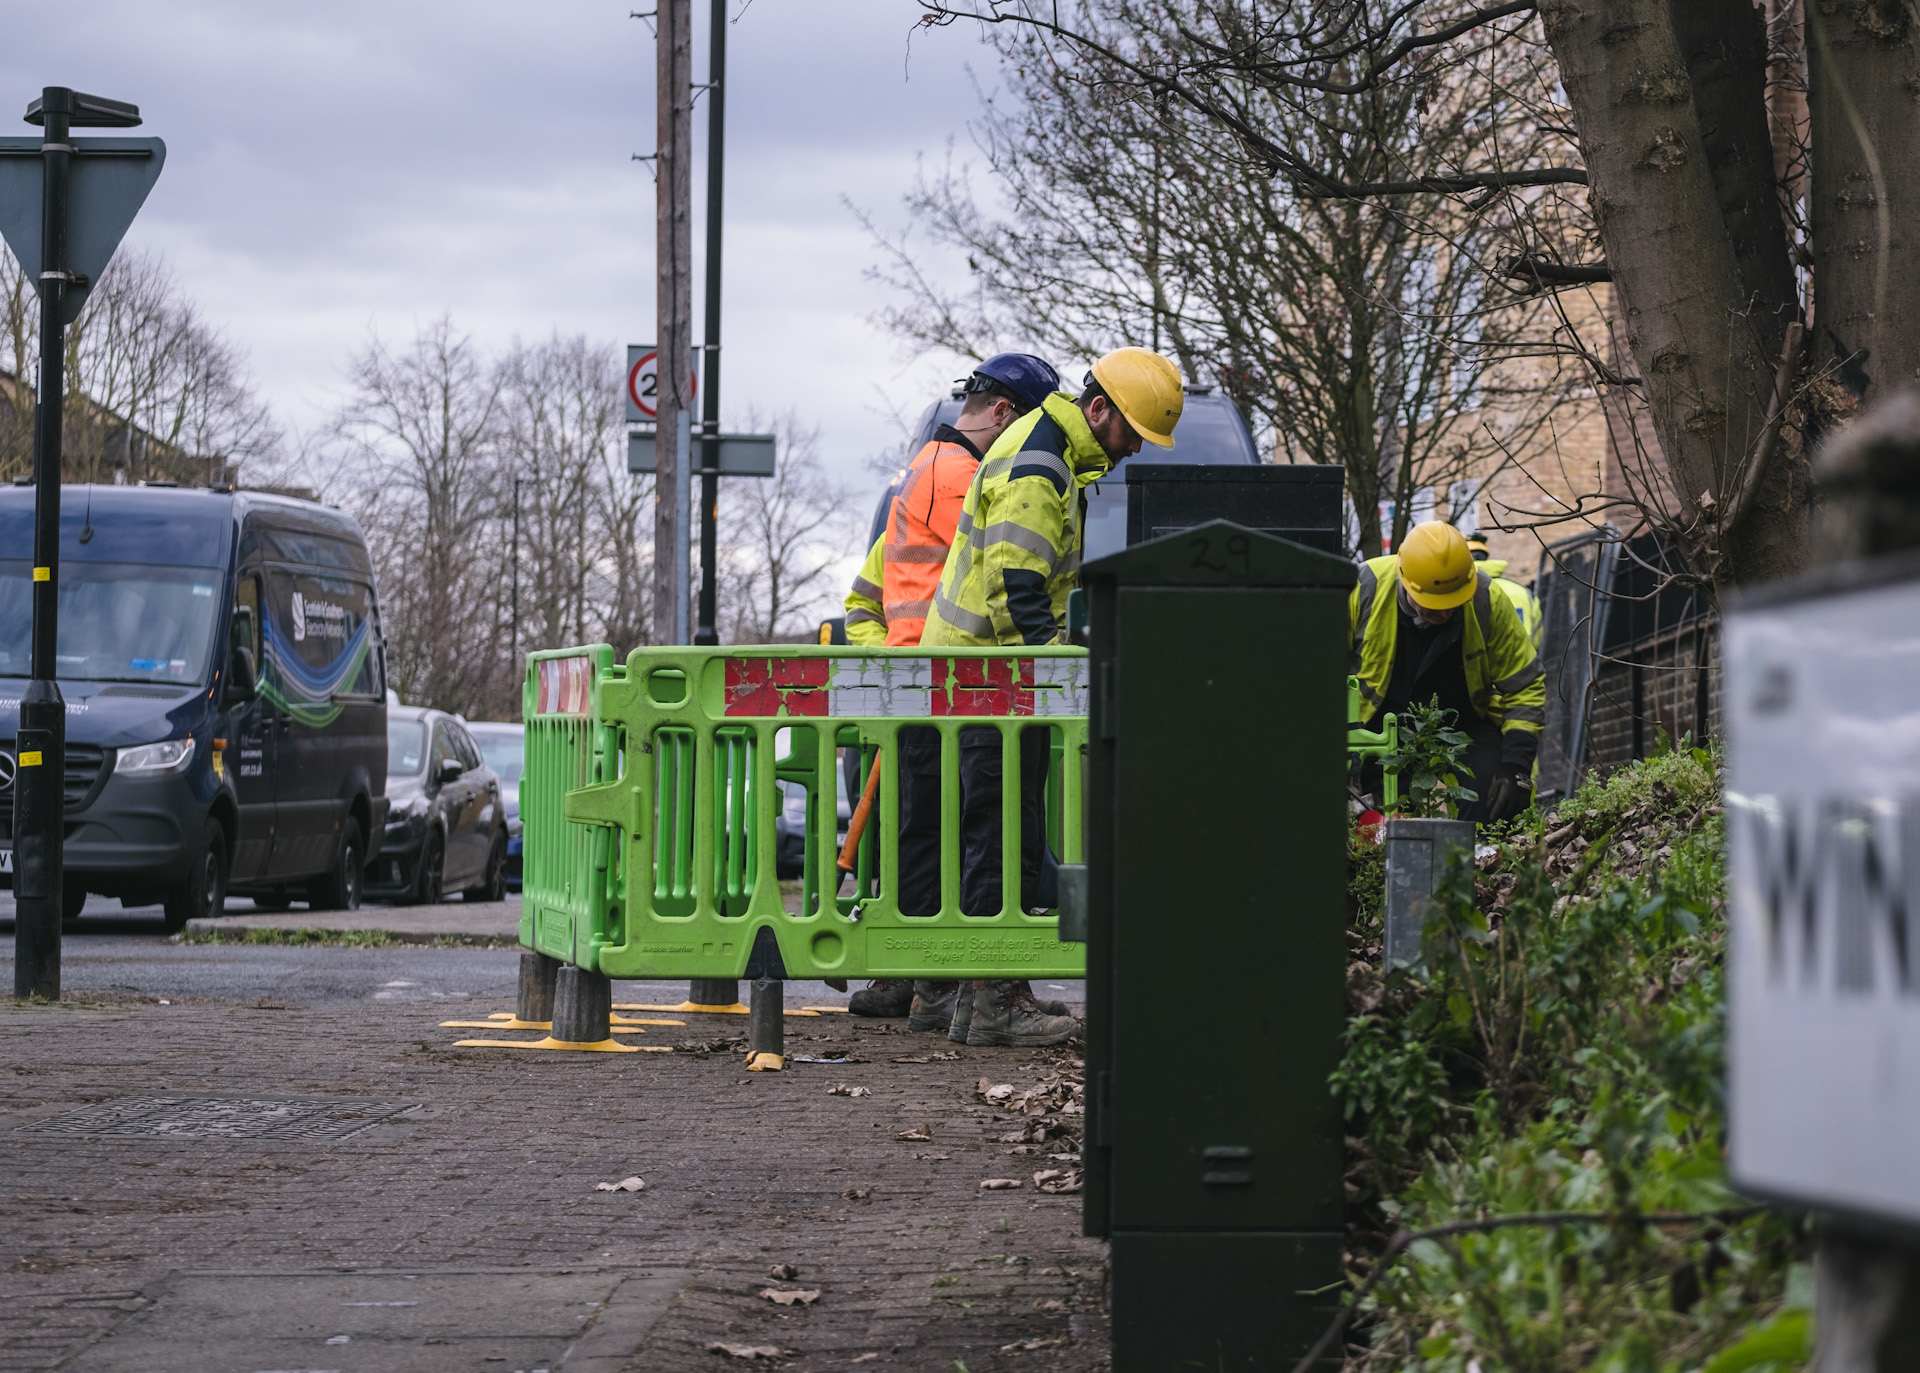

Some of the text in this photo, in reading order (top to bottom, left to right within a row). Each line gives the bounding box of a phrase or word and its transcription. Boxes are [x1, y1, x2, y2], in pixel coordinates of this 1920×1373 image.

[641, 373, 657, 396] 2
[1189, 535, 1249, 575] 29
[669, 944, 694, 953] Barrier
[885, 936, 937, 950] Scottish
[941, 936, 965, 950] and
[969, 936, 1028, 950] Southern
[923, 950, 1040, 963] Power Distribution
